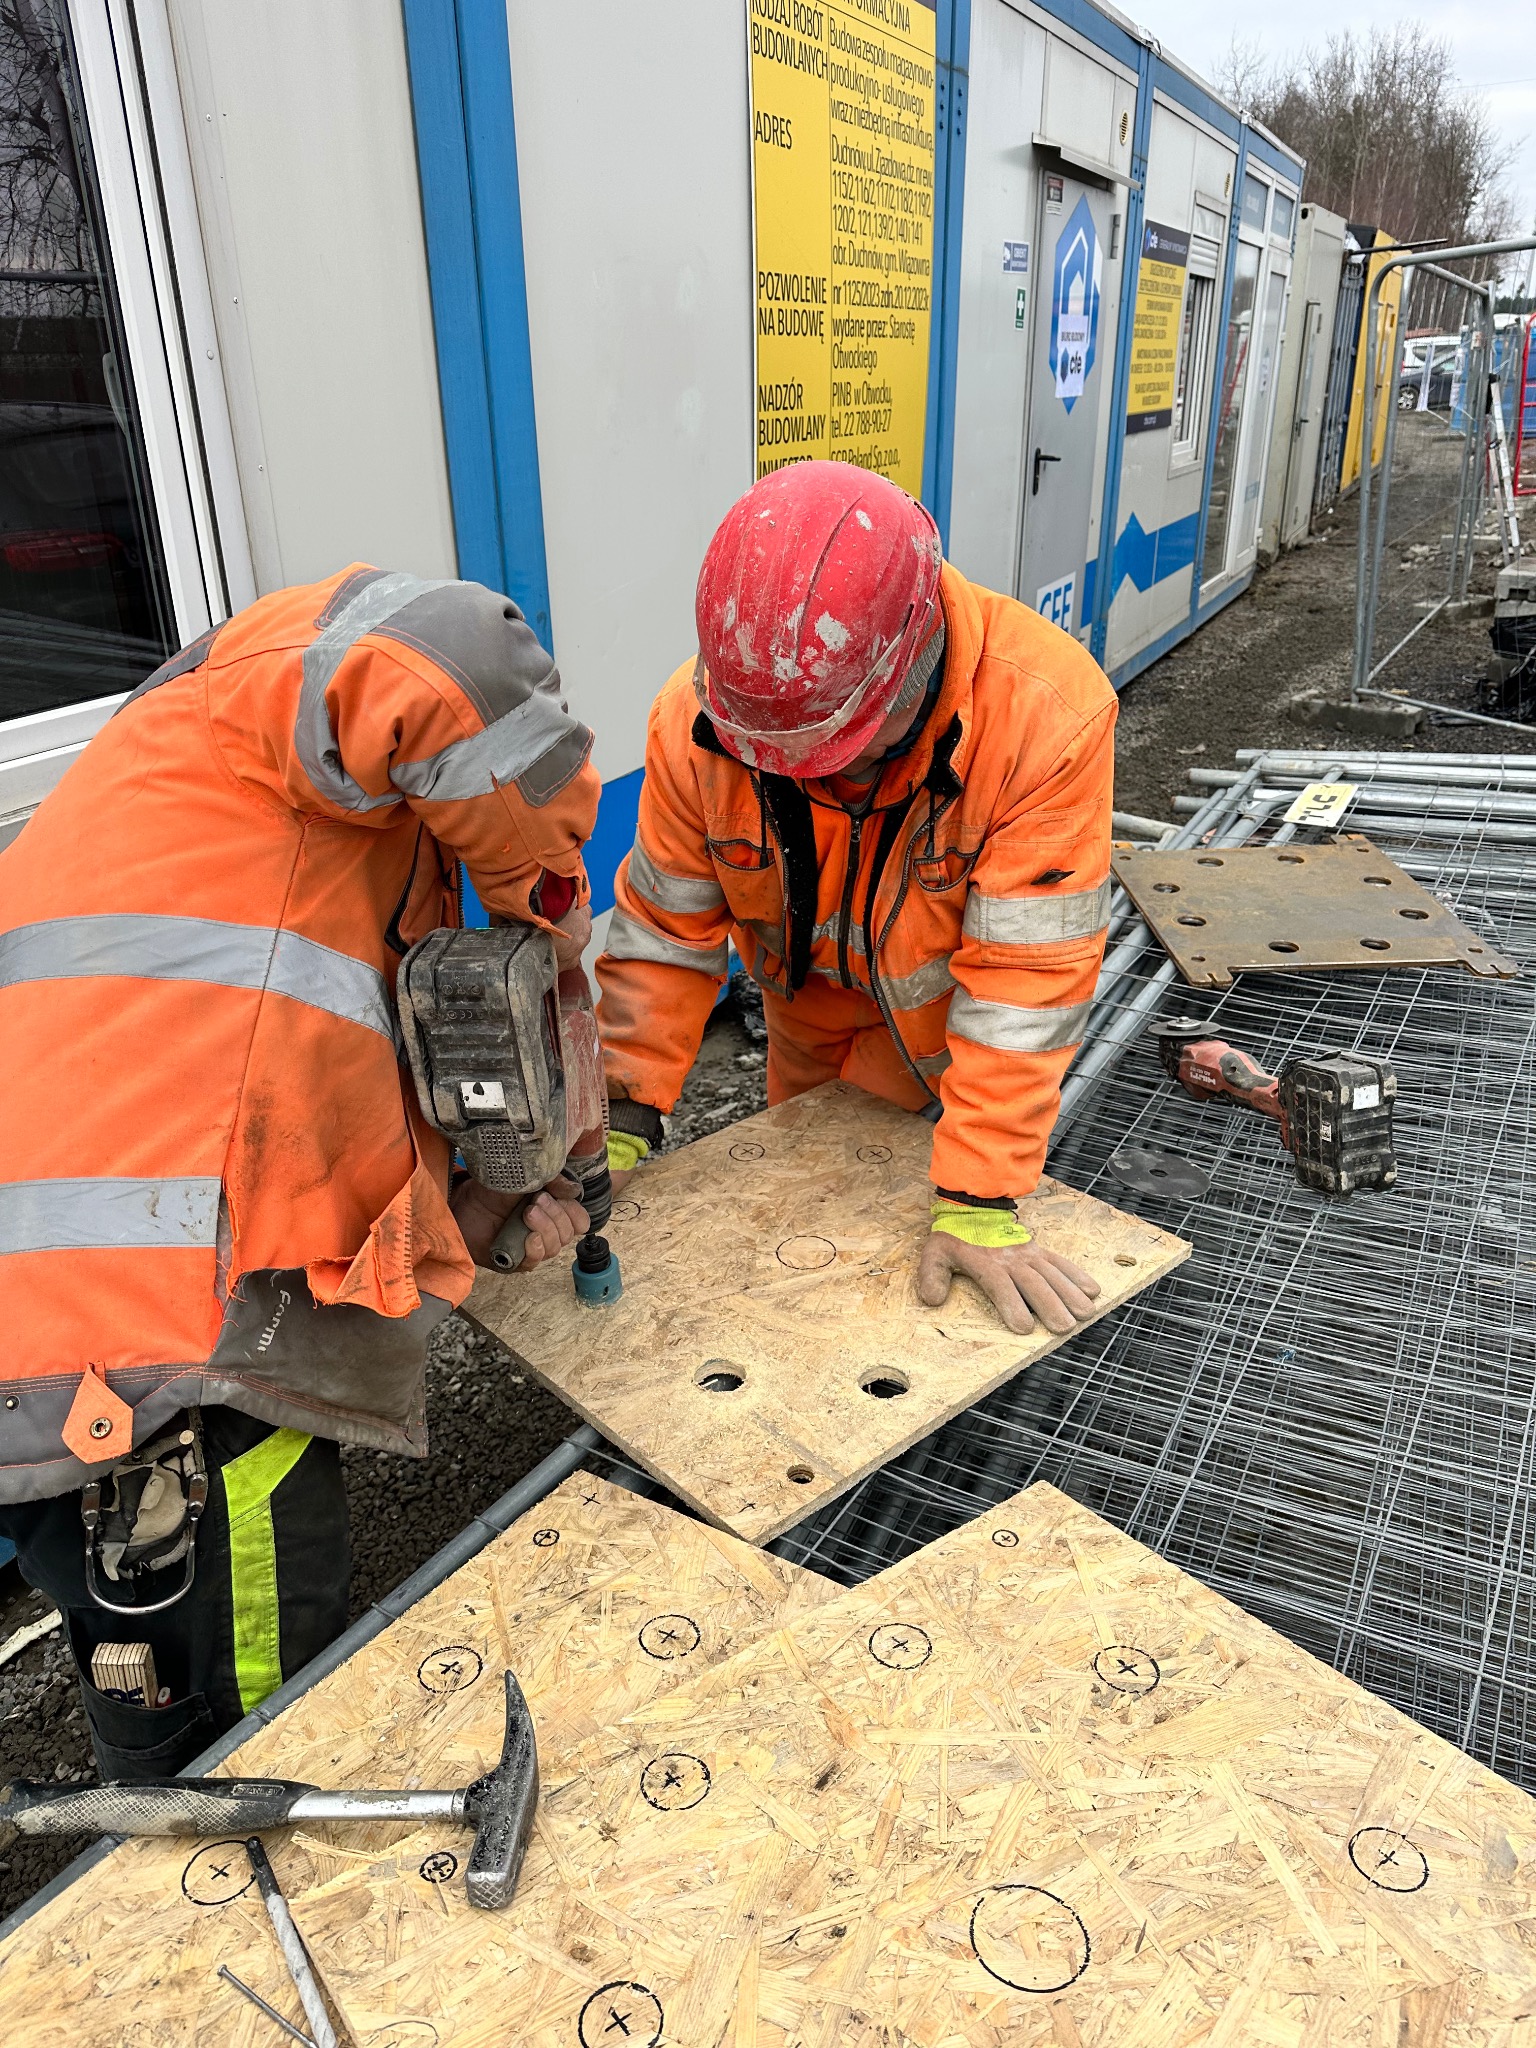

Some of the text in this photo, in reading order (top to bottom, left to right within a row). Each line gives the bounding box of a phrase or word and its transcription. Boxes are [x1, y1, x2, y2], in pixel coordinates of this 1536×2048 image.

[794, 2, 823, 42] ROBÓT
[844, 0, 910, 34] MACYJNA
[753, 22, 829, 81] BUDOWLANYCH
[830, 17, 933, 89] Budowa zespołu magazynowo-
[830, 59, 924, 123] produkcyjno- usługowego
[755, 111, 792, 150] ADRES
[831, 98, 848, 123] wraz
[854, 101, 891, 144] niezbędną
[832, 134, 866, 175] Duchnów,
[866, 144, 875, 172] ul.
[876, 148, 906, 182] Zjazdowa,
[833, 170, 932, 222] 115/2, 116/2, 117/2, 118/2, 119/2,
[833, 204, 857, 239] 120/2,
[858, 209, 874, 241] 121,
[874, 213, 895, 245] 139/2,
[895, 217, 908, 243] 140
[911, 221, 922, 246] 141
[833, 236, 929, 281] obr. Duchnów, gm. Wiązowna
[758, 271, 827, 304] POZWOLENIE
[833, 285, 841, 304] nr
[843, 280, 880, 307] 1125/2023
[759, 307, 824, 344] NA BUDOWĘ
[833, 310, 915, 345] wydane przez: Starostę
[832, 342, 877, 375] Otwockiego
[1070, 351, 1082, 374] cfe
[759, 377, 803, 412] NADZÓR
[832, 379, 892, 407] PINB w Otwocku,
[759, 414, 826, 446] BUDOWLANY
[831, 409, 892, 438] tel. 22 788-90-27
[1190, 1071, 1216, 1085] HILTI
